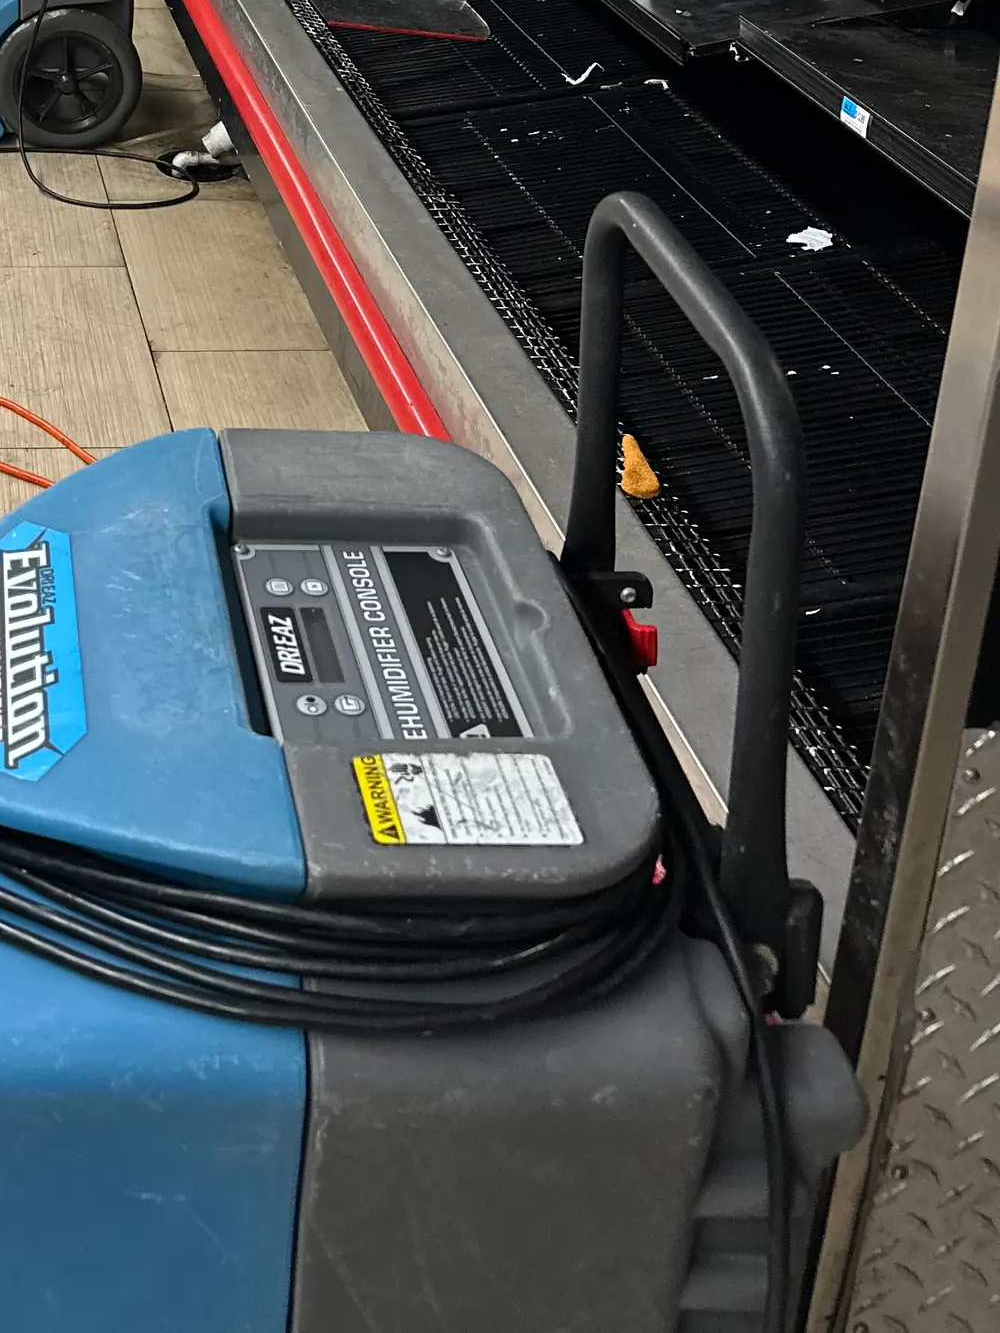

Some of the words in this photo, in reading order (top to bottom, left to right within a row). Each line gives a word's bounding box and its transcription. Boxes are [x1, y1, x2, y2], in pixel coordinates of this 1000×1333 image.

[342, 549, 387, 623] CONSOLE
[1, 542, 56, 768] Evolution
[366, 626, 428, 741] EHUMIDIFIER
[360, 754, 394, 824] WARNING
